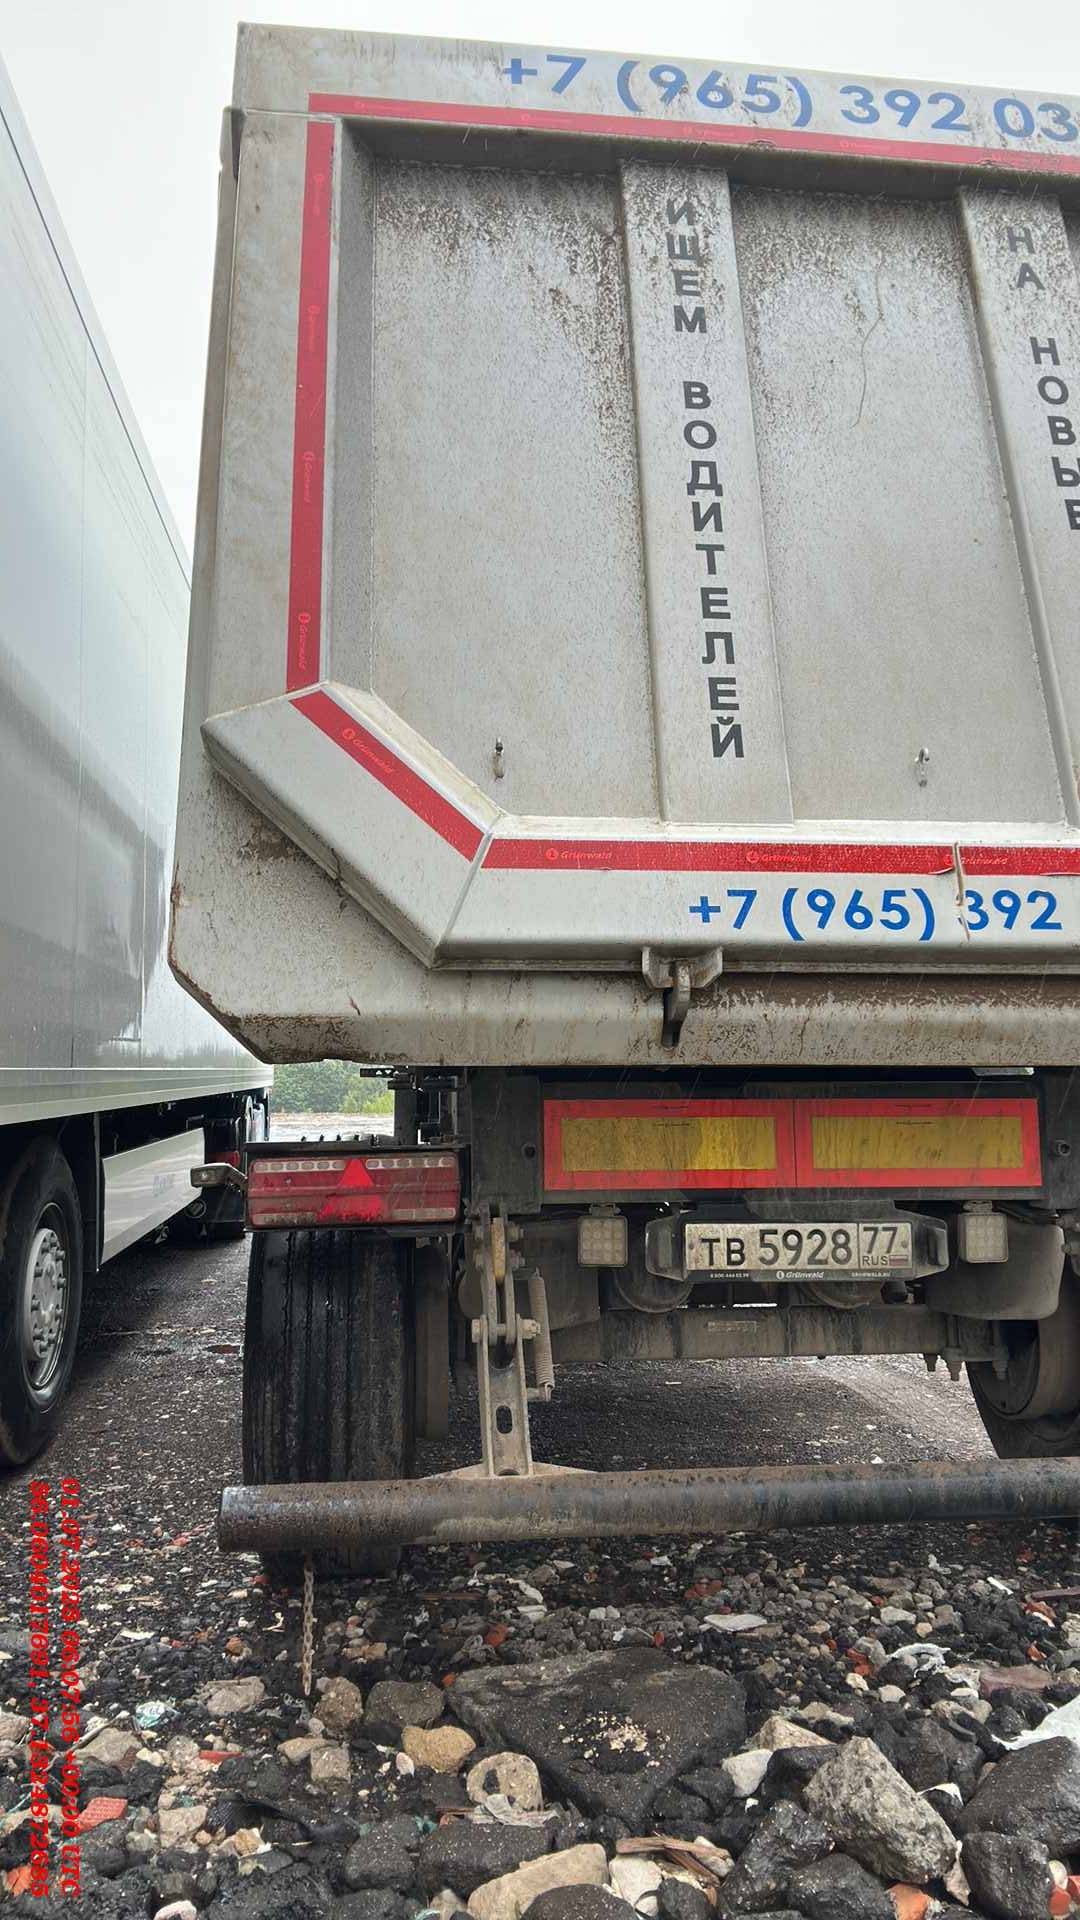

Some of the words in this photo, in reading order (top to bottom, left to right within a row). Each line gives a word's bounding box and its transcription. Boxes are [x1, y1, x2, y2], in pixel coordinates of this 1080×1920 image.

[503, 54, 586, 95] +7
[616, 60, 812, 127] (965)
[840, 85, 971, 132] 392
[993, 98, 1079, 141] 03
[666, 199, 706, 333] ИЩЕМ
[1007, 226, 1045, 290] НА
[683, 381, 744, 758] ВОДИТЕЛЕЙ
[689, 889, 757, 930] +7
[782, 887, 936, 941] (965)
[957, 889, 1063, 931] 392
[758, 1229, 851, 1266] 5928
[863, 1227, 898, 1255] 77
[862, 1255, 888, 1266] RUS
